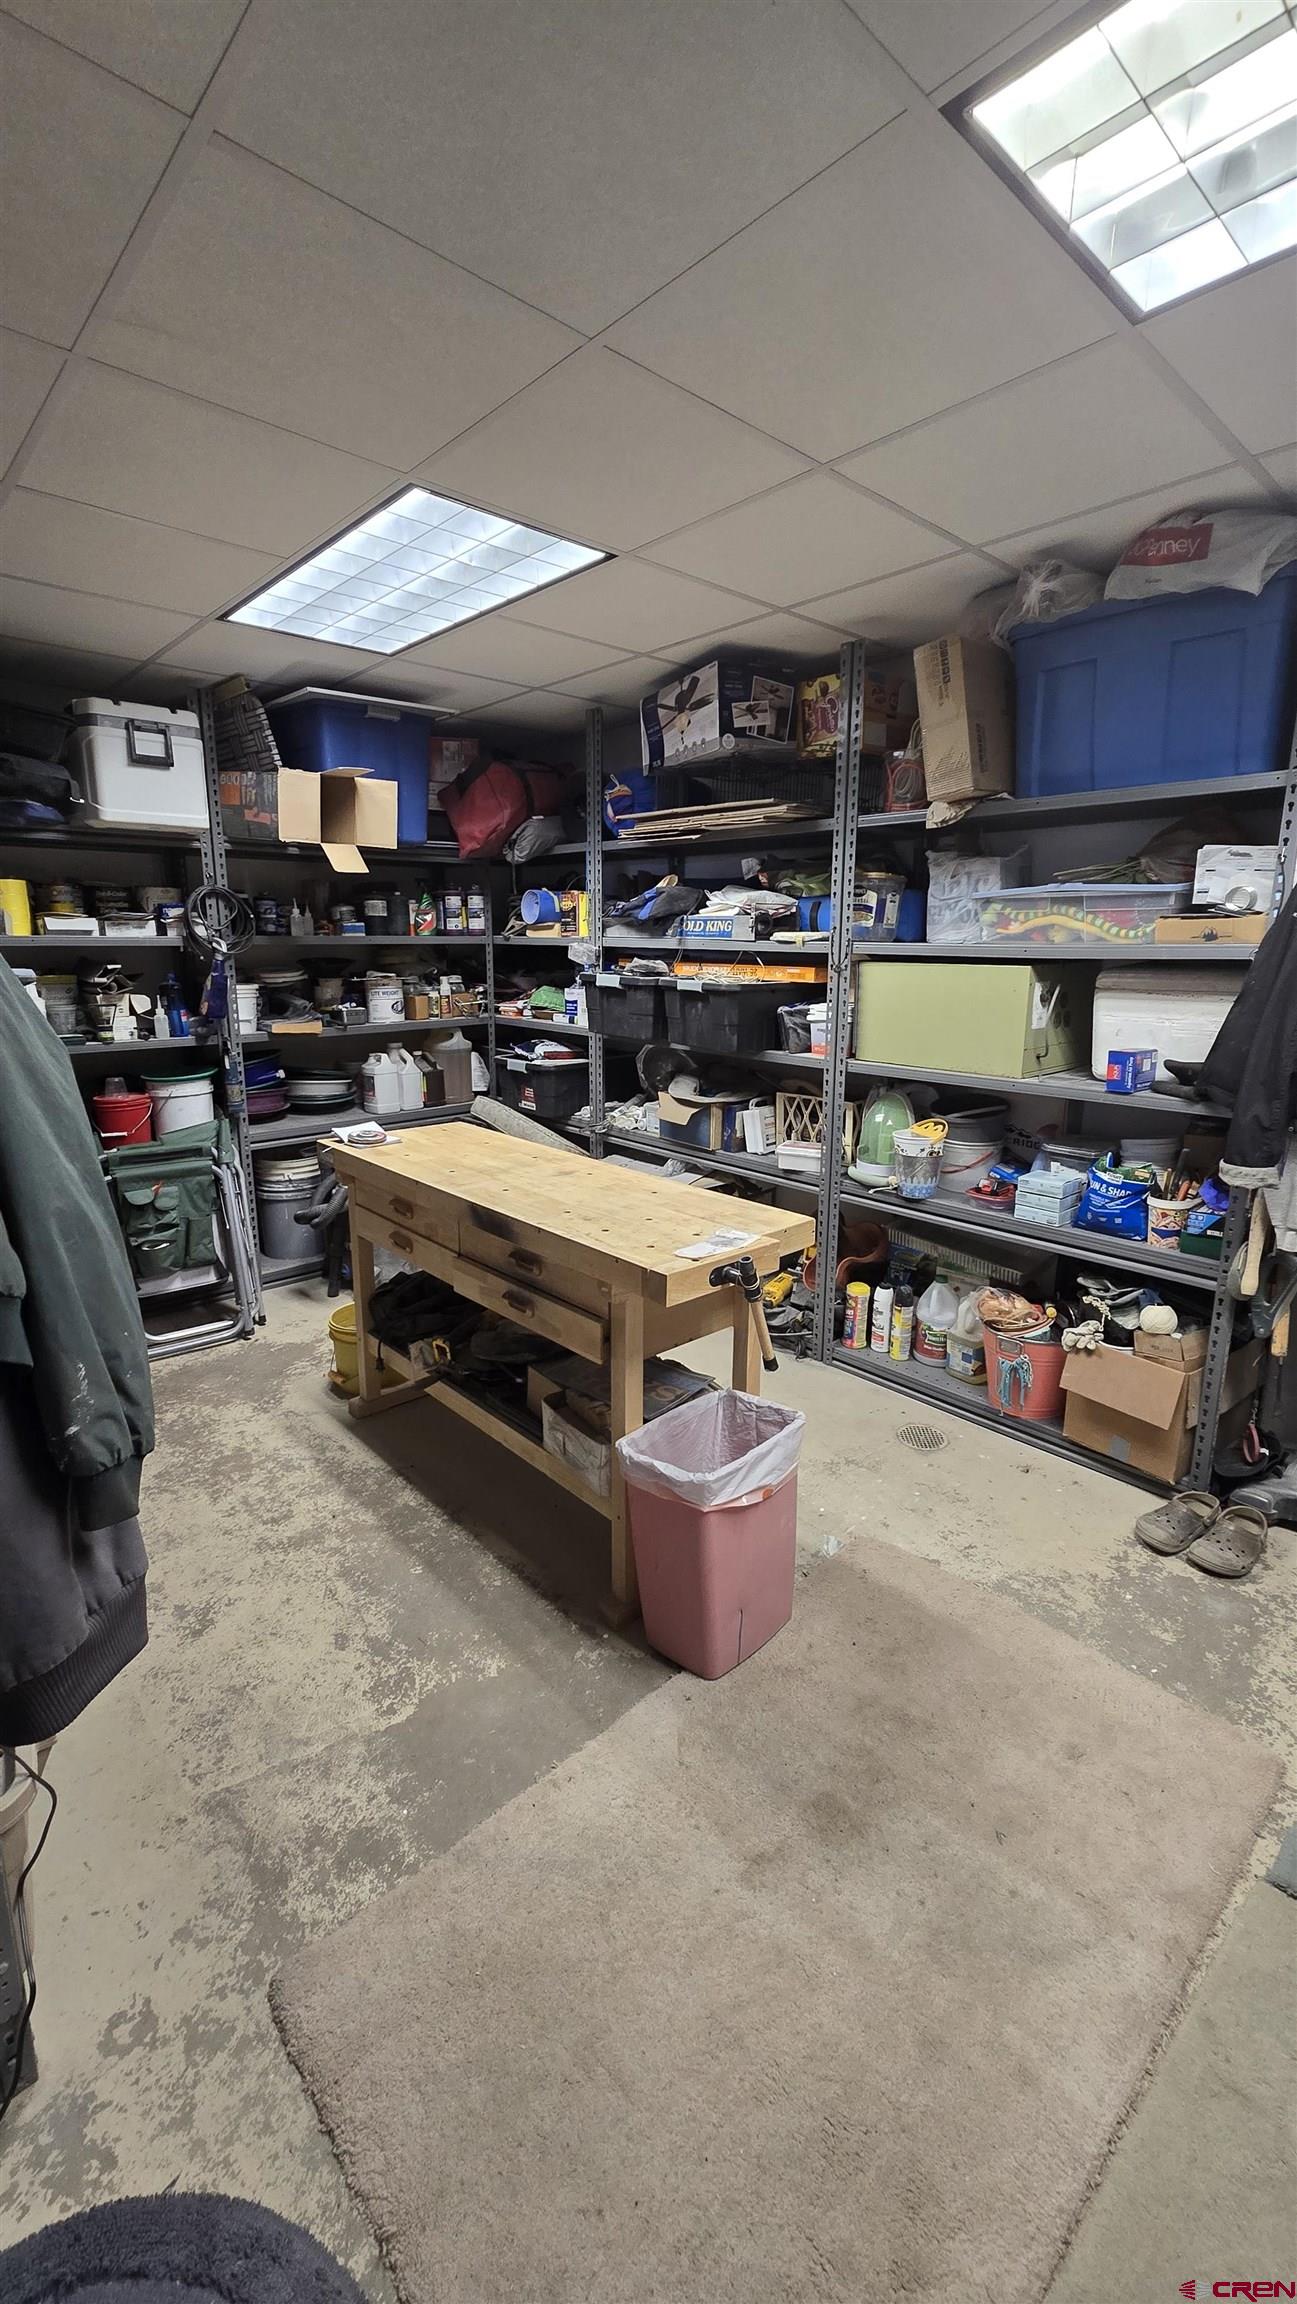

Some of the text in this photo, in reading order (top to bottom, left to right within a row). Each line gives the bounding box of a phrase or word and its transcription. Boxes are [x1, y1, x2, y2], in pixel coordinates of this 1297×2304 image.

[683, 920, 733, 932] OLD KING
[1100, 1183, 1107, 1192] &
